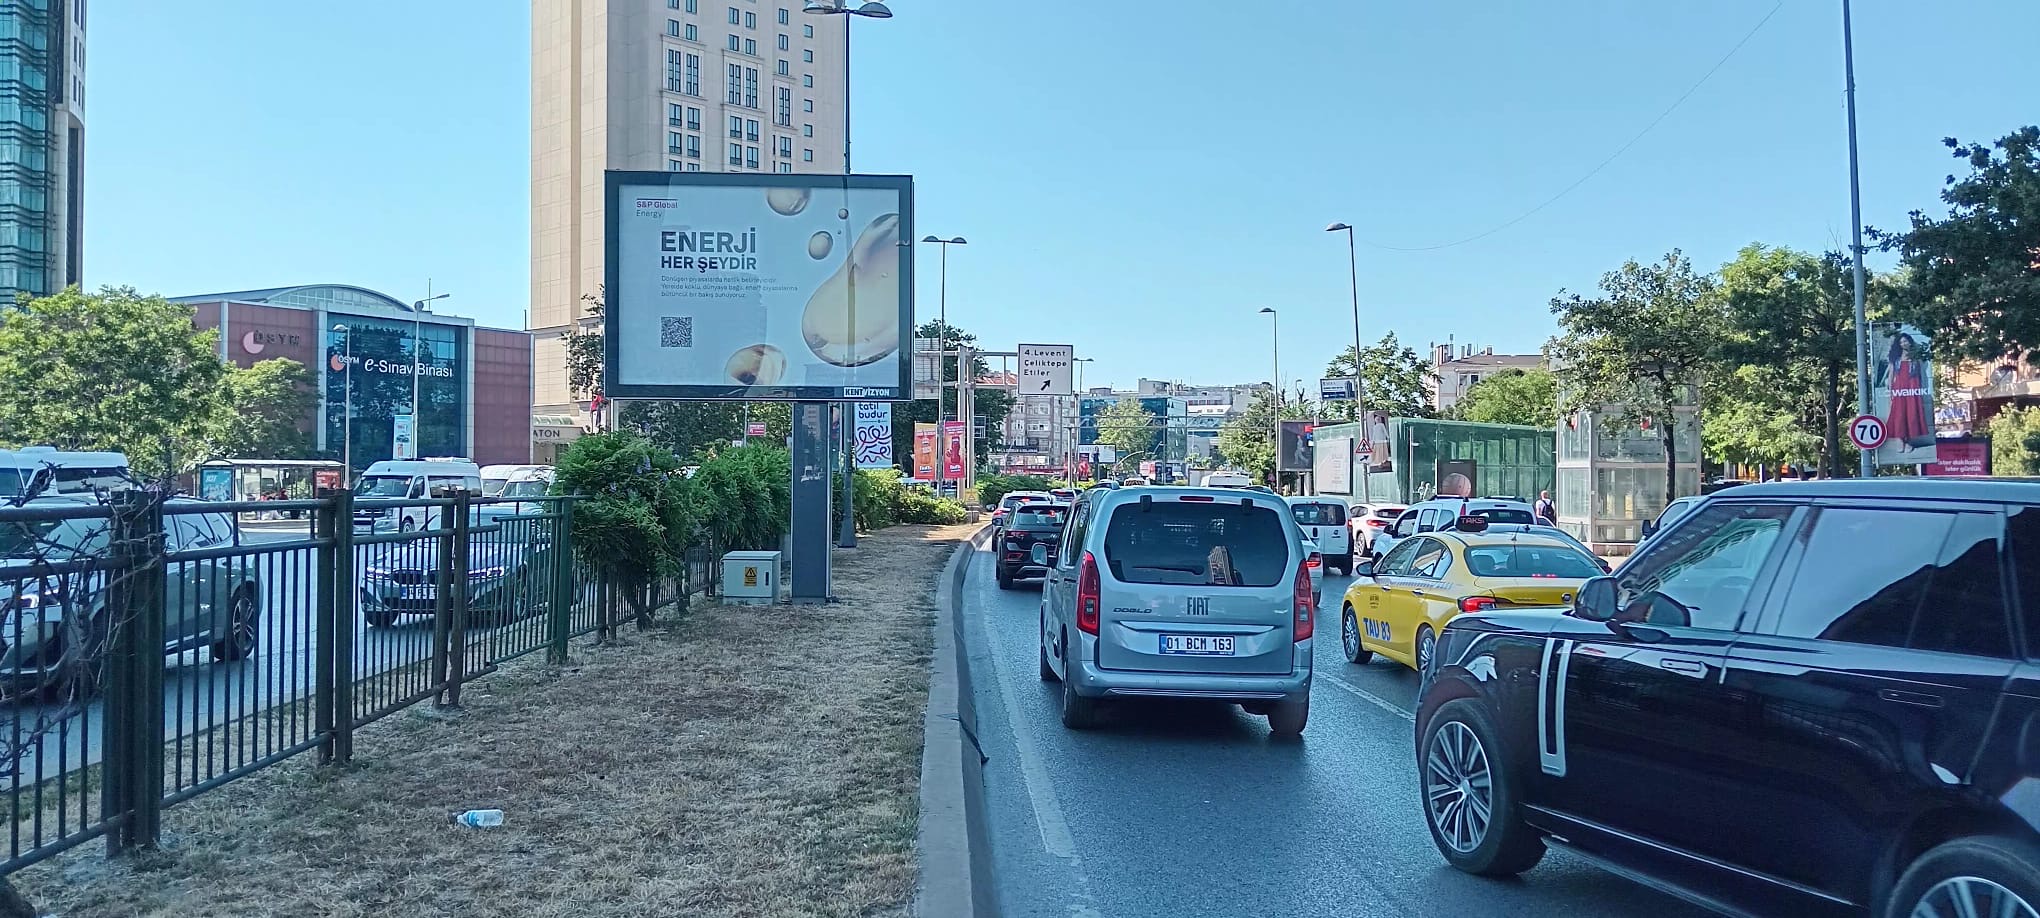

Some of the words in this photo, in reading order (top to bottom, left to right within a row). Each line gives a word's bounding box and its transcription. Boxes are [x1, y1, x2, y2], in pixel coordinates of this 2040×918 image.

[654, 201, 678, 209] Global
[636, 210, 663, 218] Energy
[661, 227, 756, 253] ENERJİ
[661, 256, 694, 269] HER
[697, 254, 757, 273] ŞEYDİR
[365, 358, 414, 375] e-Sınav
[417, 362, 453, 378] Binası
[1024, 359, 1067, 368] Çeliktepe
[858, 410, 888, 419] budur
[1857, 424, 1880, 440] 70
[1186, 597, 1211, 616] FIAT
[1363, 617, 1380, 638] TAU
[1381, 620, 1391, 641] 83
[1166, 636, 1180, 650] 01
[1213, 638, 1232, 651] 163
